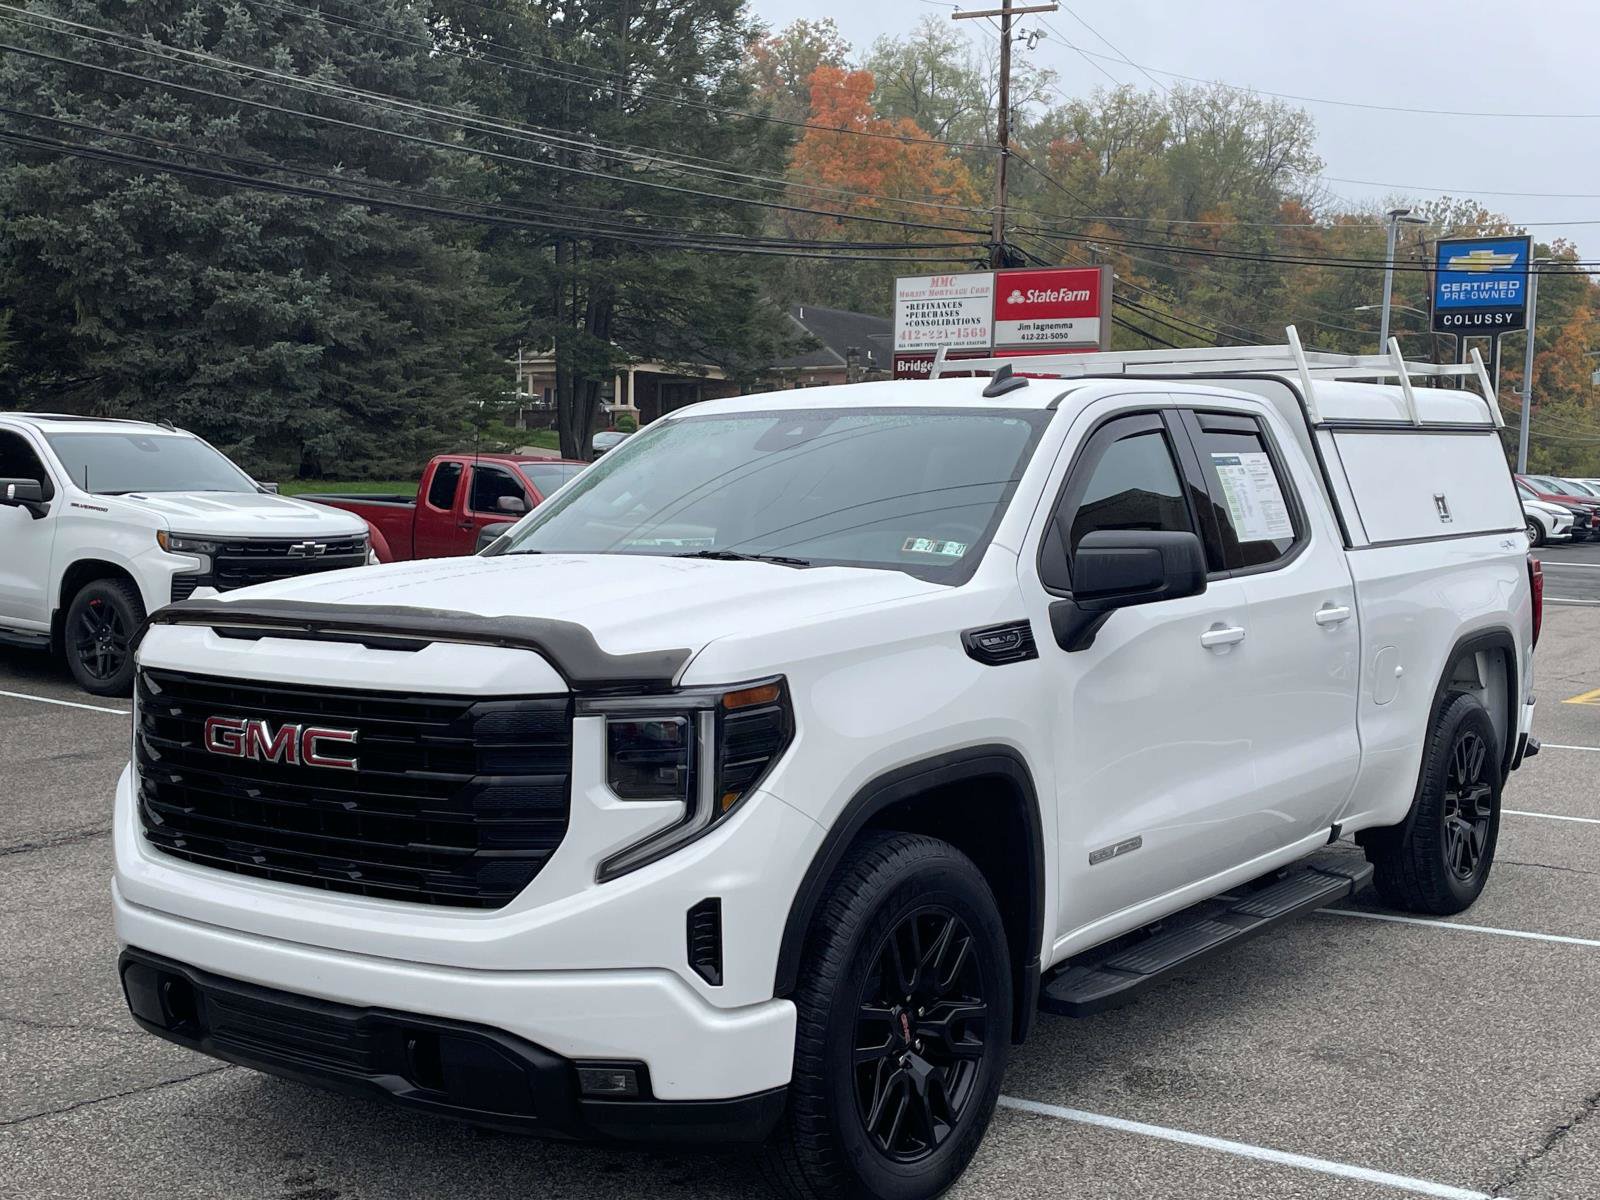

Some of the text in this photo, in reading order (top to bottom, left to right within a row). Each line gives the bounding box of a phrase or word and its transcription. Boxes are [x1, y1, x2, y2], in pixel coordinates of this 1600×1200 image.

[930, 277, 957, 288] MMC
[1441, 281, 1519, 292] CERTIFIED
[1444, 290, 1515, 300] PRE-OWNED
[909, 301, 963, 311] REFINANCES
[909, 310, 960, 319] PURCHASES
[1443, 313, 1513, 325] COLUSSY
[909, 317, 981, 327] CONSOLIDATIONS
[1017, 323, 1031, 331] Jim
[900, 327, 987, 341] 412-221-1569
[1021, 332, 1069, 341] 412-221-5050
[204, 715, 360, 771] GMC
